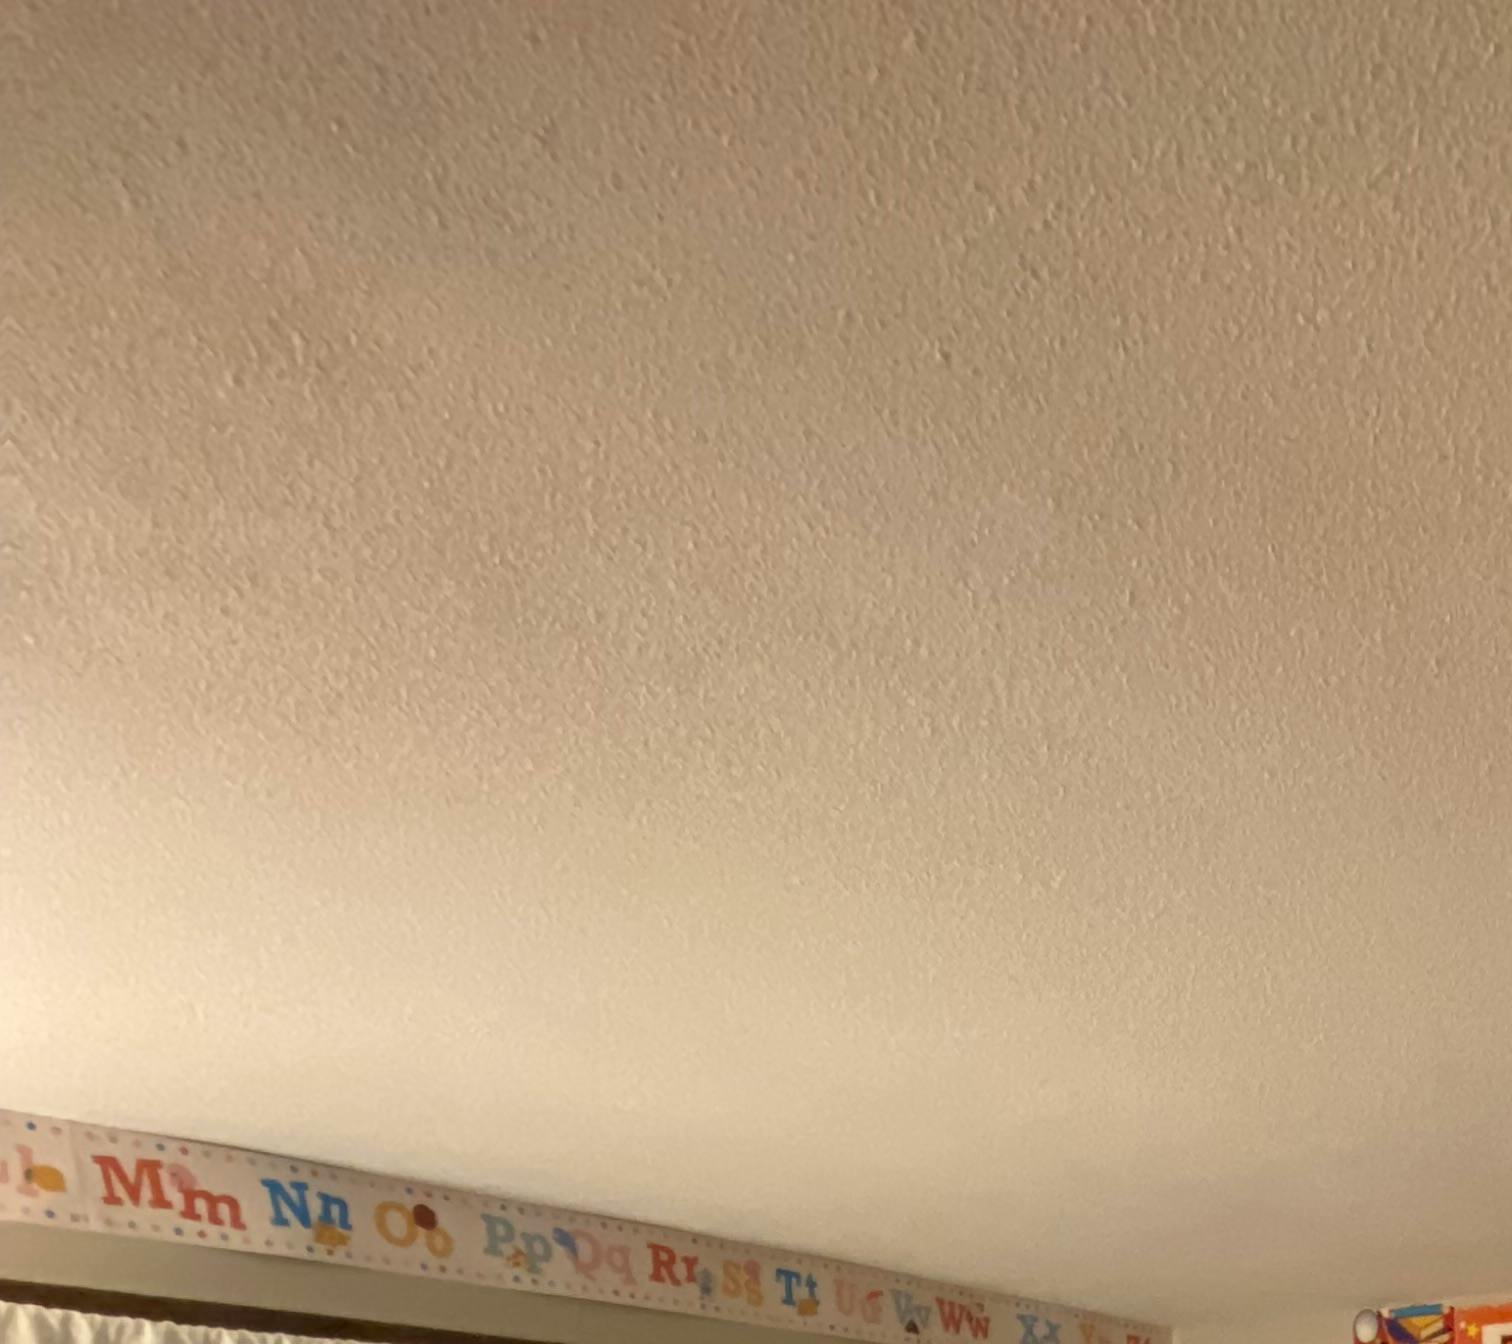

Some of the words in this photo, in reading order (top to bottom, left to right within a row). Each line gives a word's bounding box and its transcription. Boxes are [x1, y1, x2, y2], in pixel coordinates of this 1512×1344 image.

[91, 1154, 247, 1231] Mm
[260, 1177, 353, 1231] Nn
[480, 1212, 553, 1274] Pp
